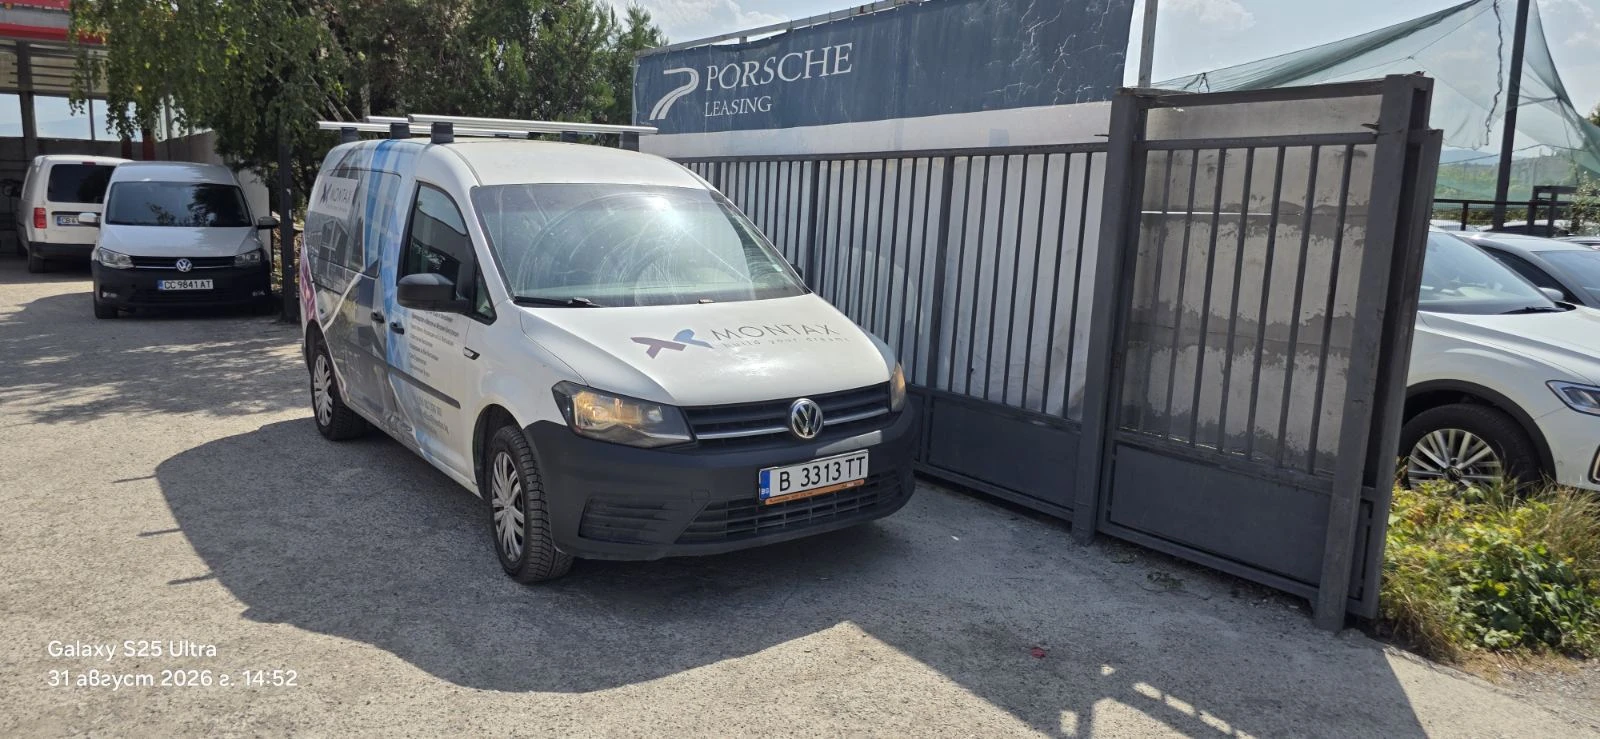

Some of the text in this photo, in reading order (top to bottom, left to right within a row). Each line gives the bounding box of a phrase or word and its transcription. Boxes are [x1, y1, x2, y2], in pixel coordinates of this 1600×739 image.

[706, 42, 853, 91] PORSCHE
[704, 96, 772, 117] LEASING
[711, 324, 839, 340] MONTAX
[779, 470, 791, 492] B
[800, 460, 841, 487] 3313
